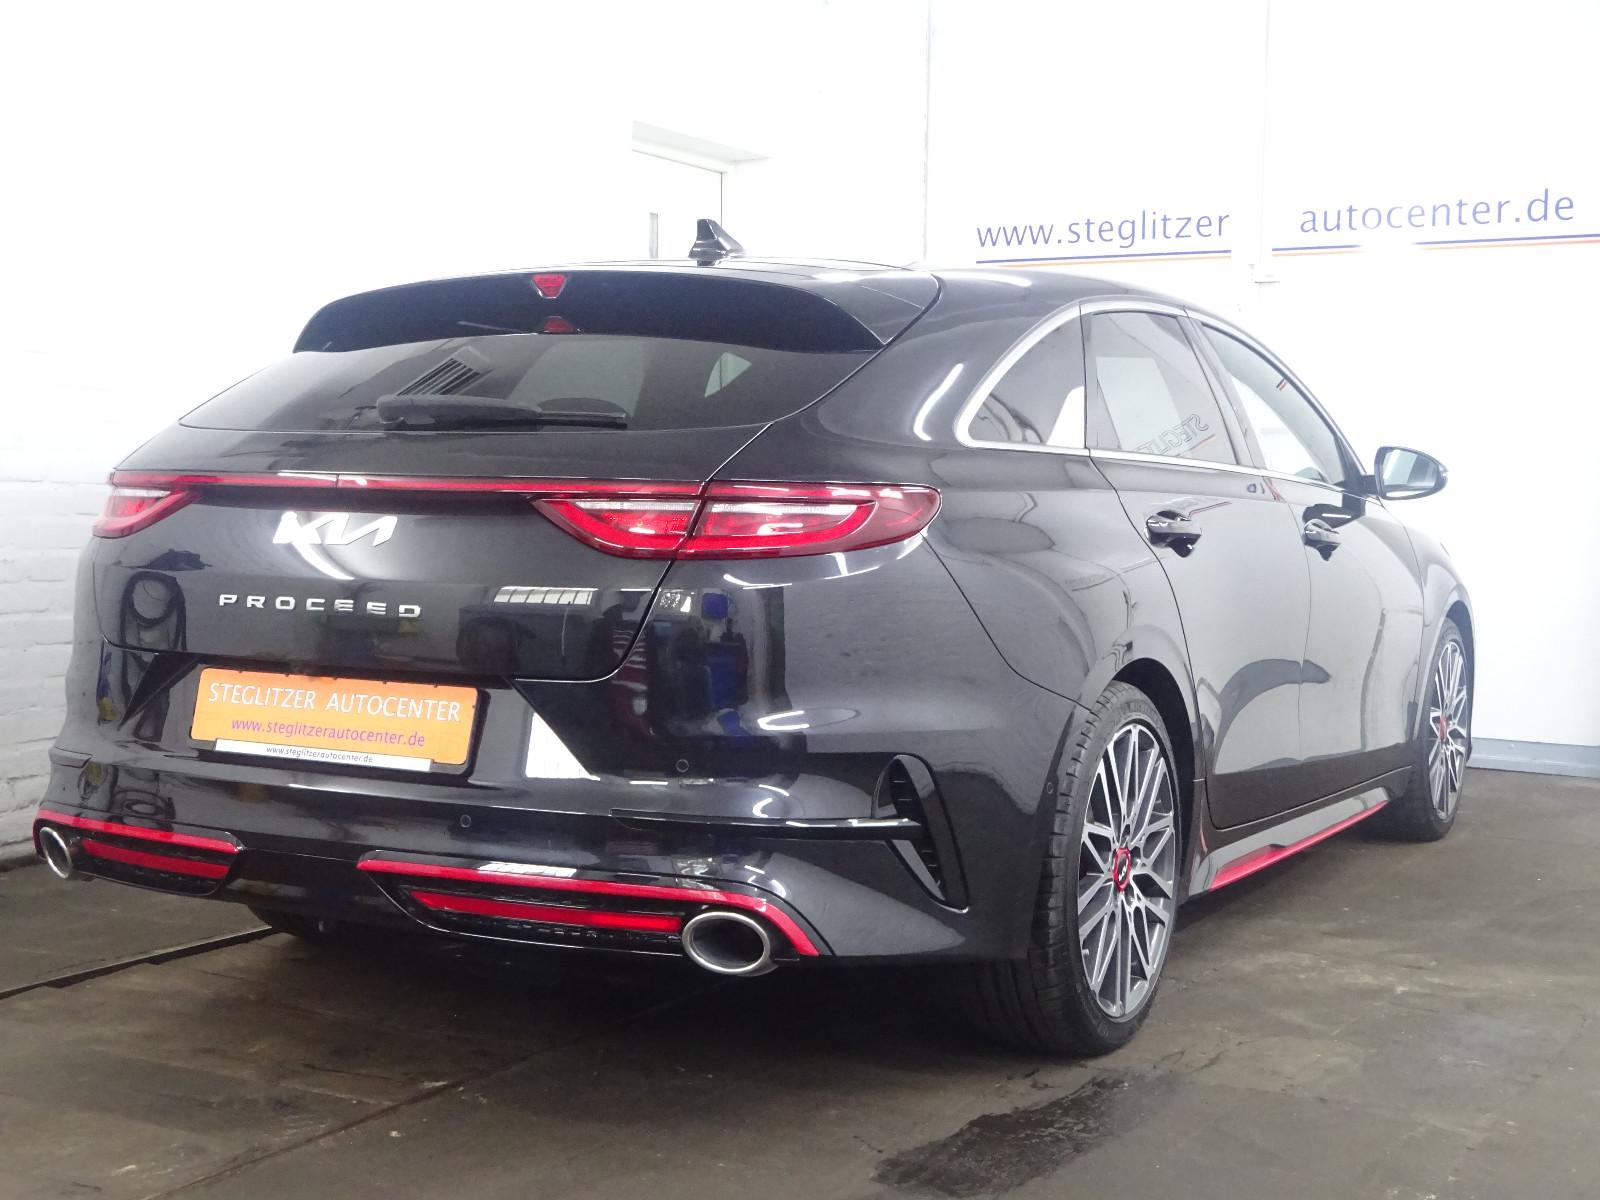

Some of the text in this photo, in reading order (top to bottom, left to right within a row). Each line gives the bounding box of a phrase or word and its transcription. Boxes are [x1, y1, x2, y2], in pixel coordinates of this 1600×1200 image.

[976, 188, 1575, 249] www.steglitzer autocenter.de
[218, 594, 422, 619] PROCEED
[208, 682, 461, 722] STEGLITZER AUTOCENTER
[231, 717, 426, 748] www.steglitzerautocenter.de
[266, 745, 374, 764] www.steglitzerautocenter.de
